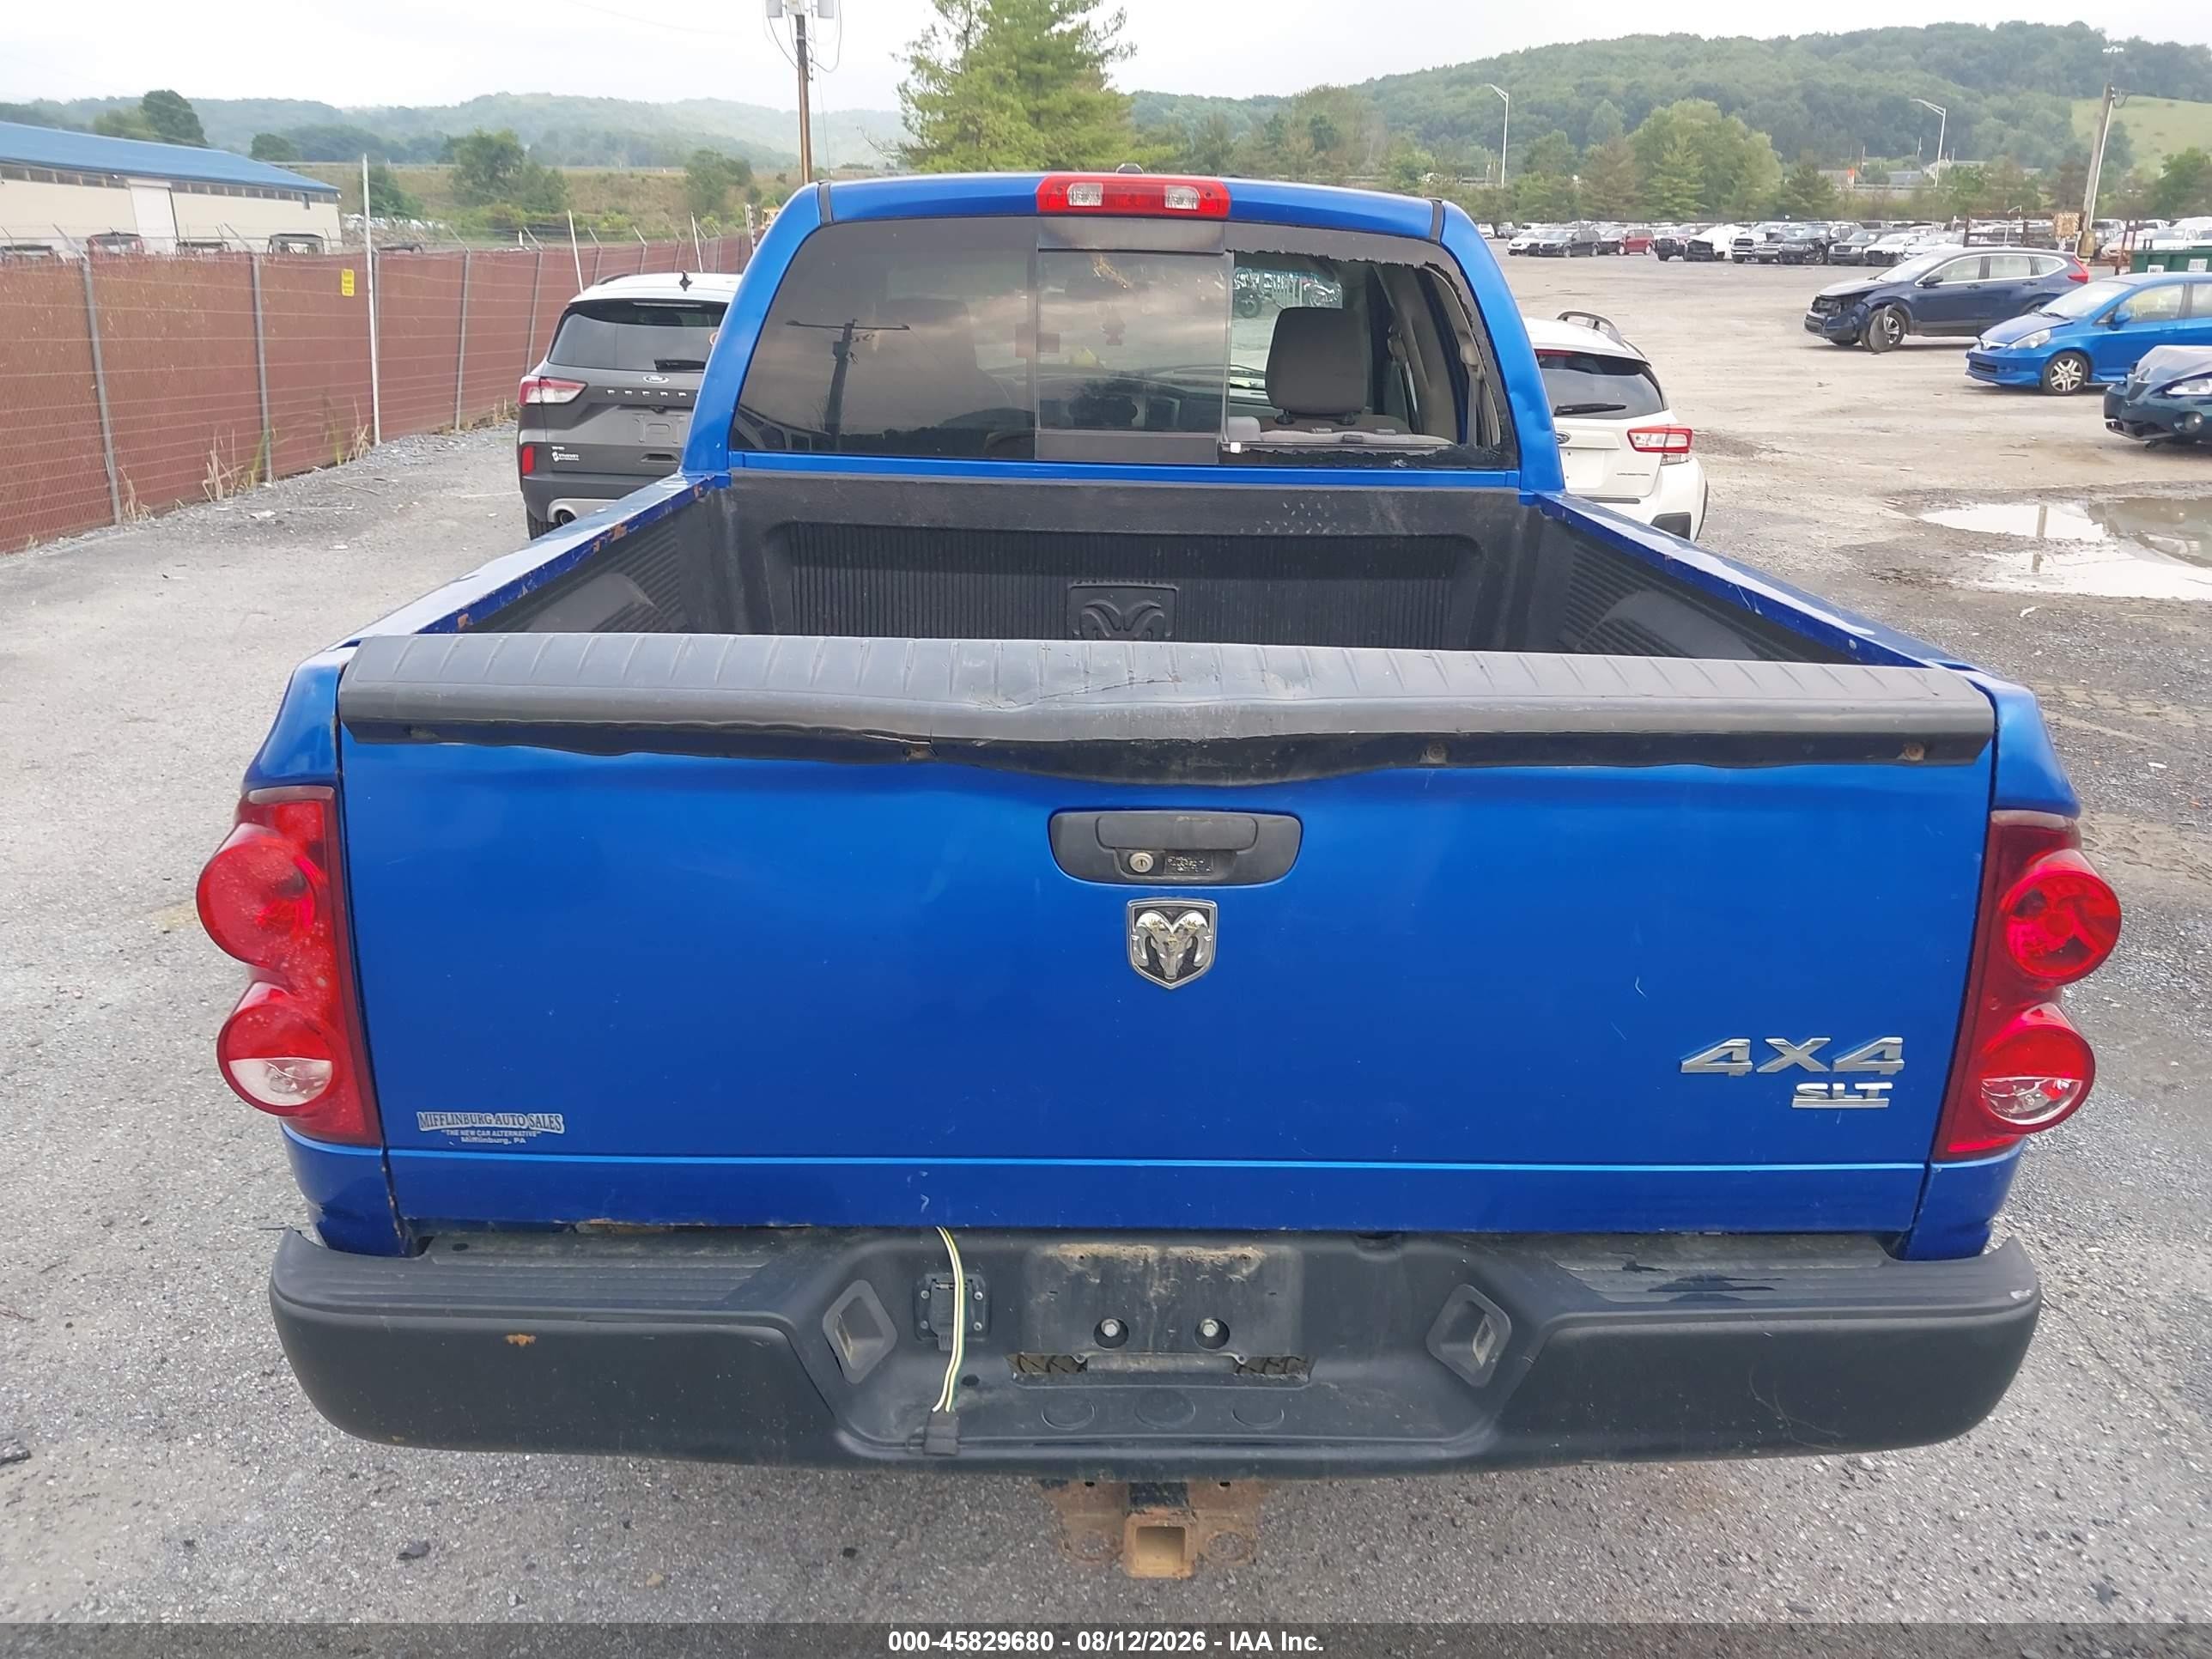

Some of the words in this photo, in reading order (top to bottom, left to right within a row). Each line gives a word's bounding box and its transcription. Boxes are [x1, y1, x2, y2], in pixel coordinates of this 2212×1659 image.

[1680, 1037, 1905, 1076] 4X4
[1795, 1082, 1893, 1099] SLT
[418, 1112, 493, 1128] MIFFLINBURG
[495, 1114, 526, 1127] AUTO
[528, 1115, 562, 1131] SALES
